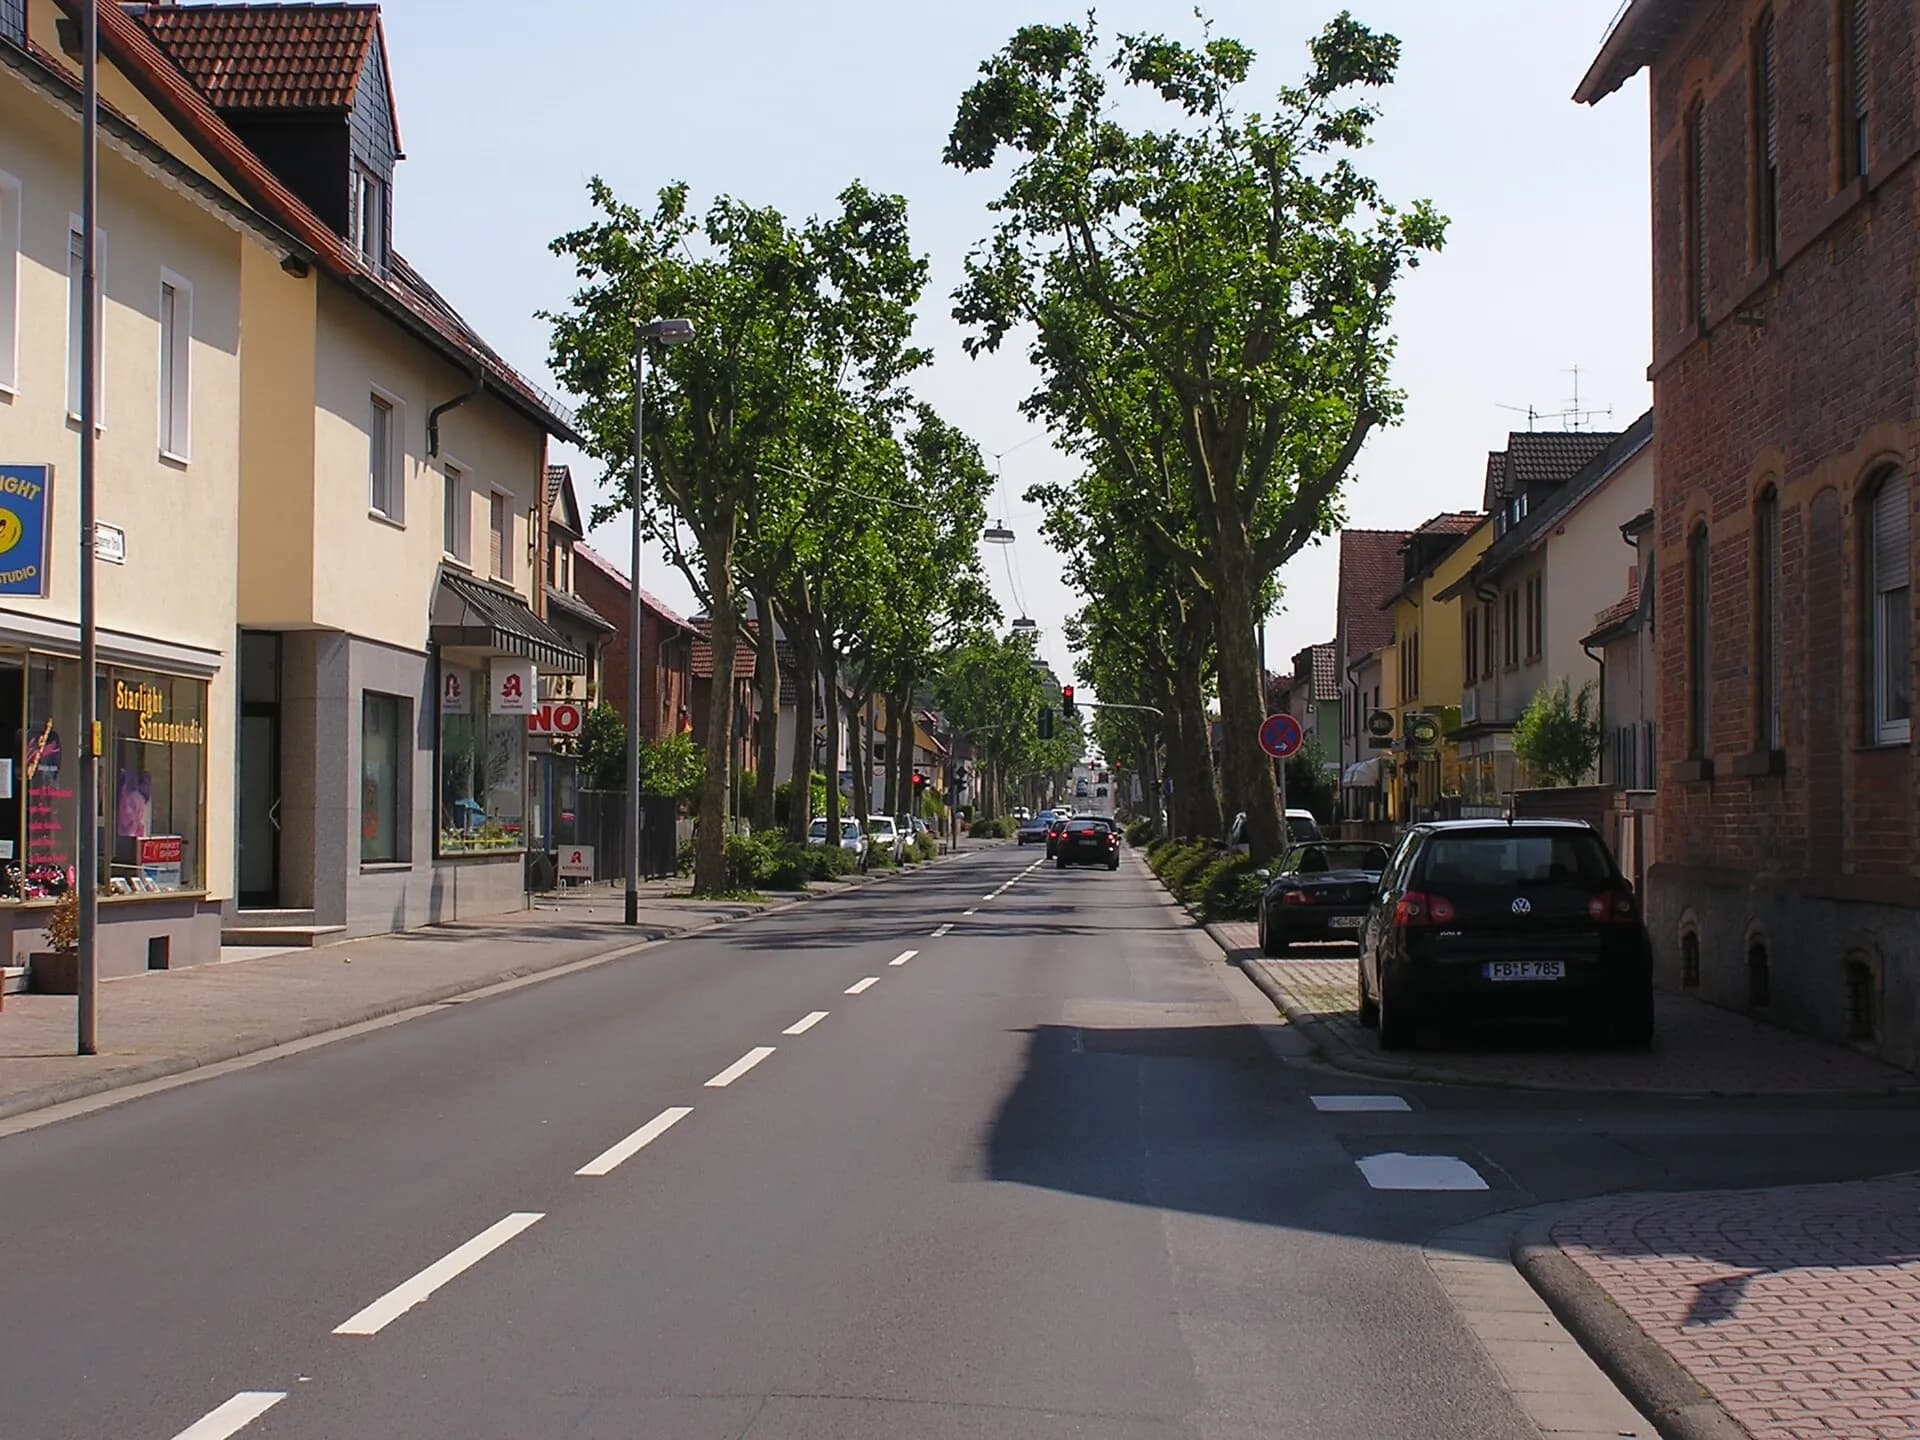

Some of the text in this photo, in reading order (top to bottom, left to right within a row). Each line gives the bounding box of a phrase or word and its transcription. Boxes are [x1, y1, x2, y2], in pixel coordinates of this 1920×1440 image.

[0, 565, 36, 584] TUDIO
[116, 681, 163, 719] Starlight
[139, 712, 204, 745] Sonnenstudio
[528, 705, 580, 732] NO
[1494, 963, 1560, 976] FB F 785
